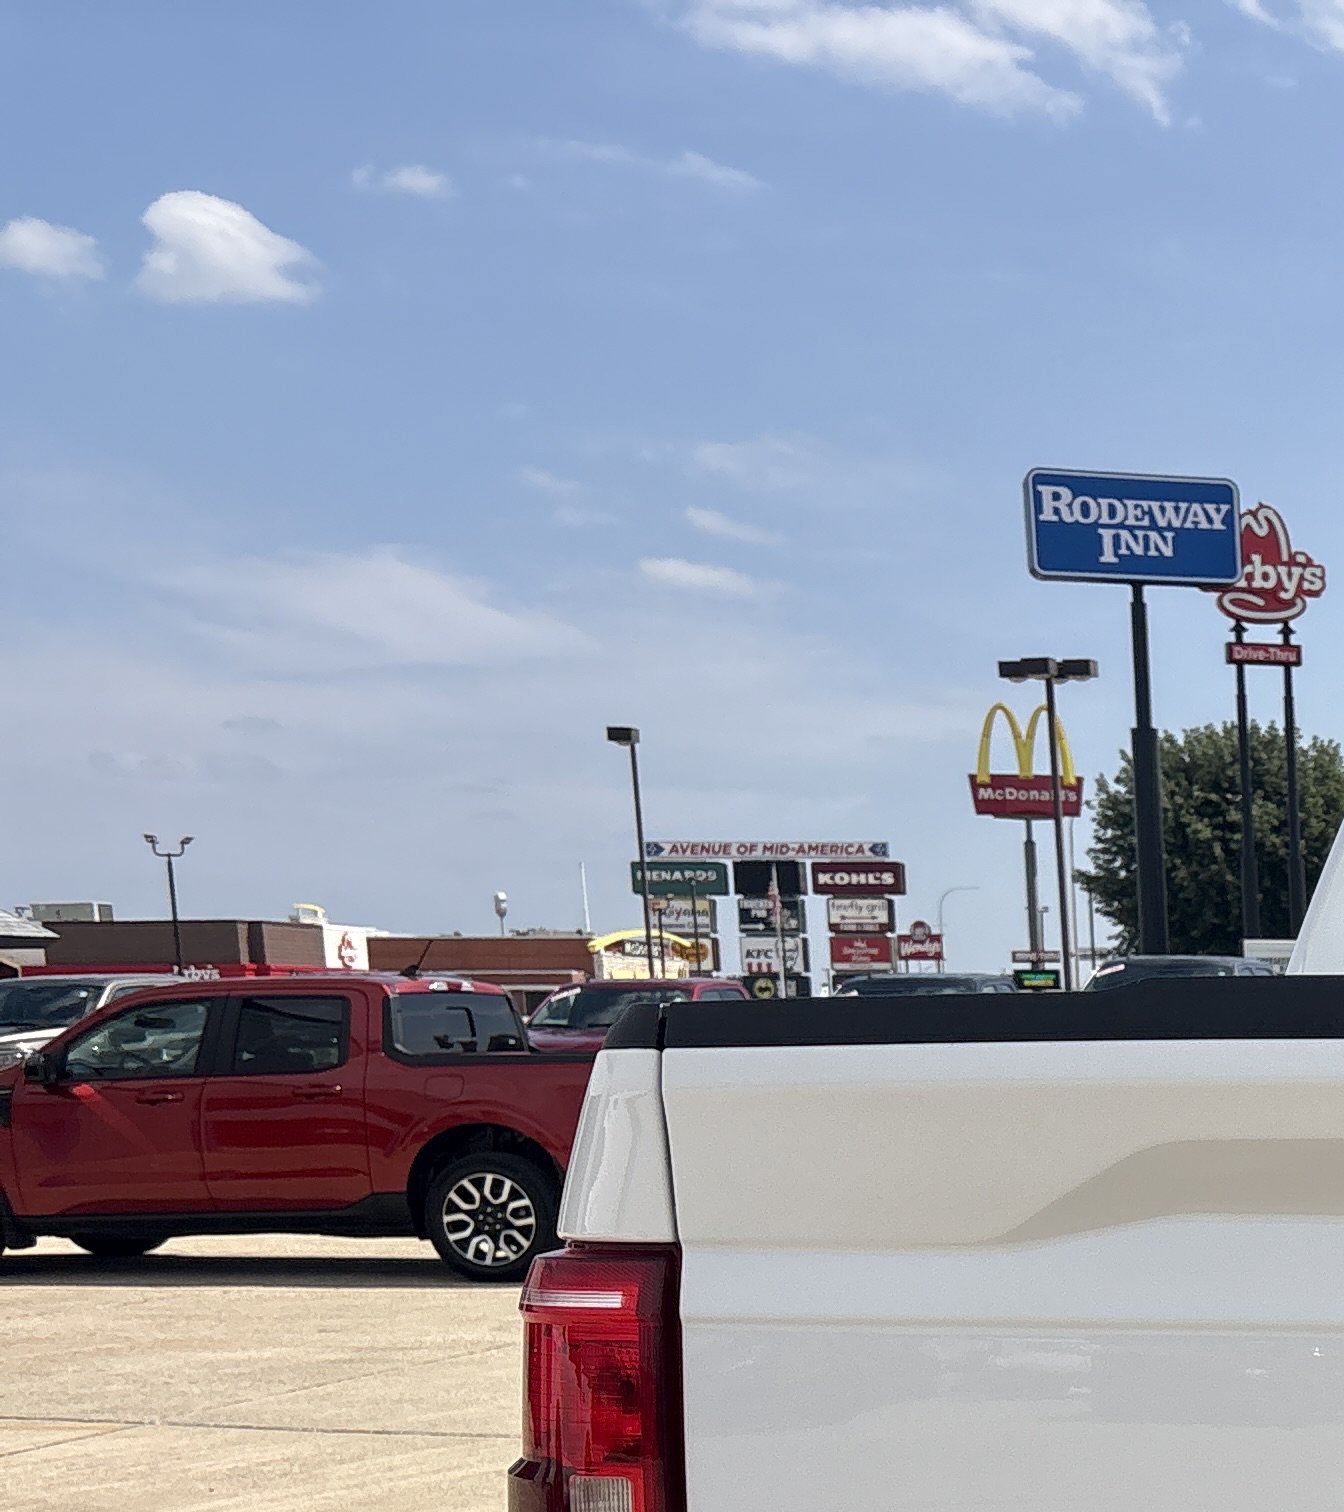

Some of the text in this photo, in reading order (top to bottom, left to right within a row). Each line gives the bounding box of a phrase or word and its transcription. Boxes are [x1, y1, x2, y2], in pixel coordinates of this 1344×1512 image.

[1036, 484, 1231, 531] RODEWAY
[1097, 528, 1175, 564] INN
[1234, 553, 1324, 600] rby's
[1231, 646, 1298, 662] Drive-Thru
[977, 786, 1078, 803] McDona's
[668, 843, 866, 857] AVENUE OF MID-AMERICA
[817, 872, 896, 886] KOHL'S
[745, 948, 774, 960] KFC
